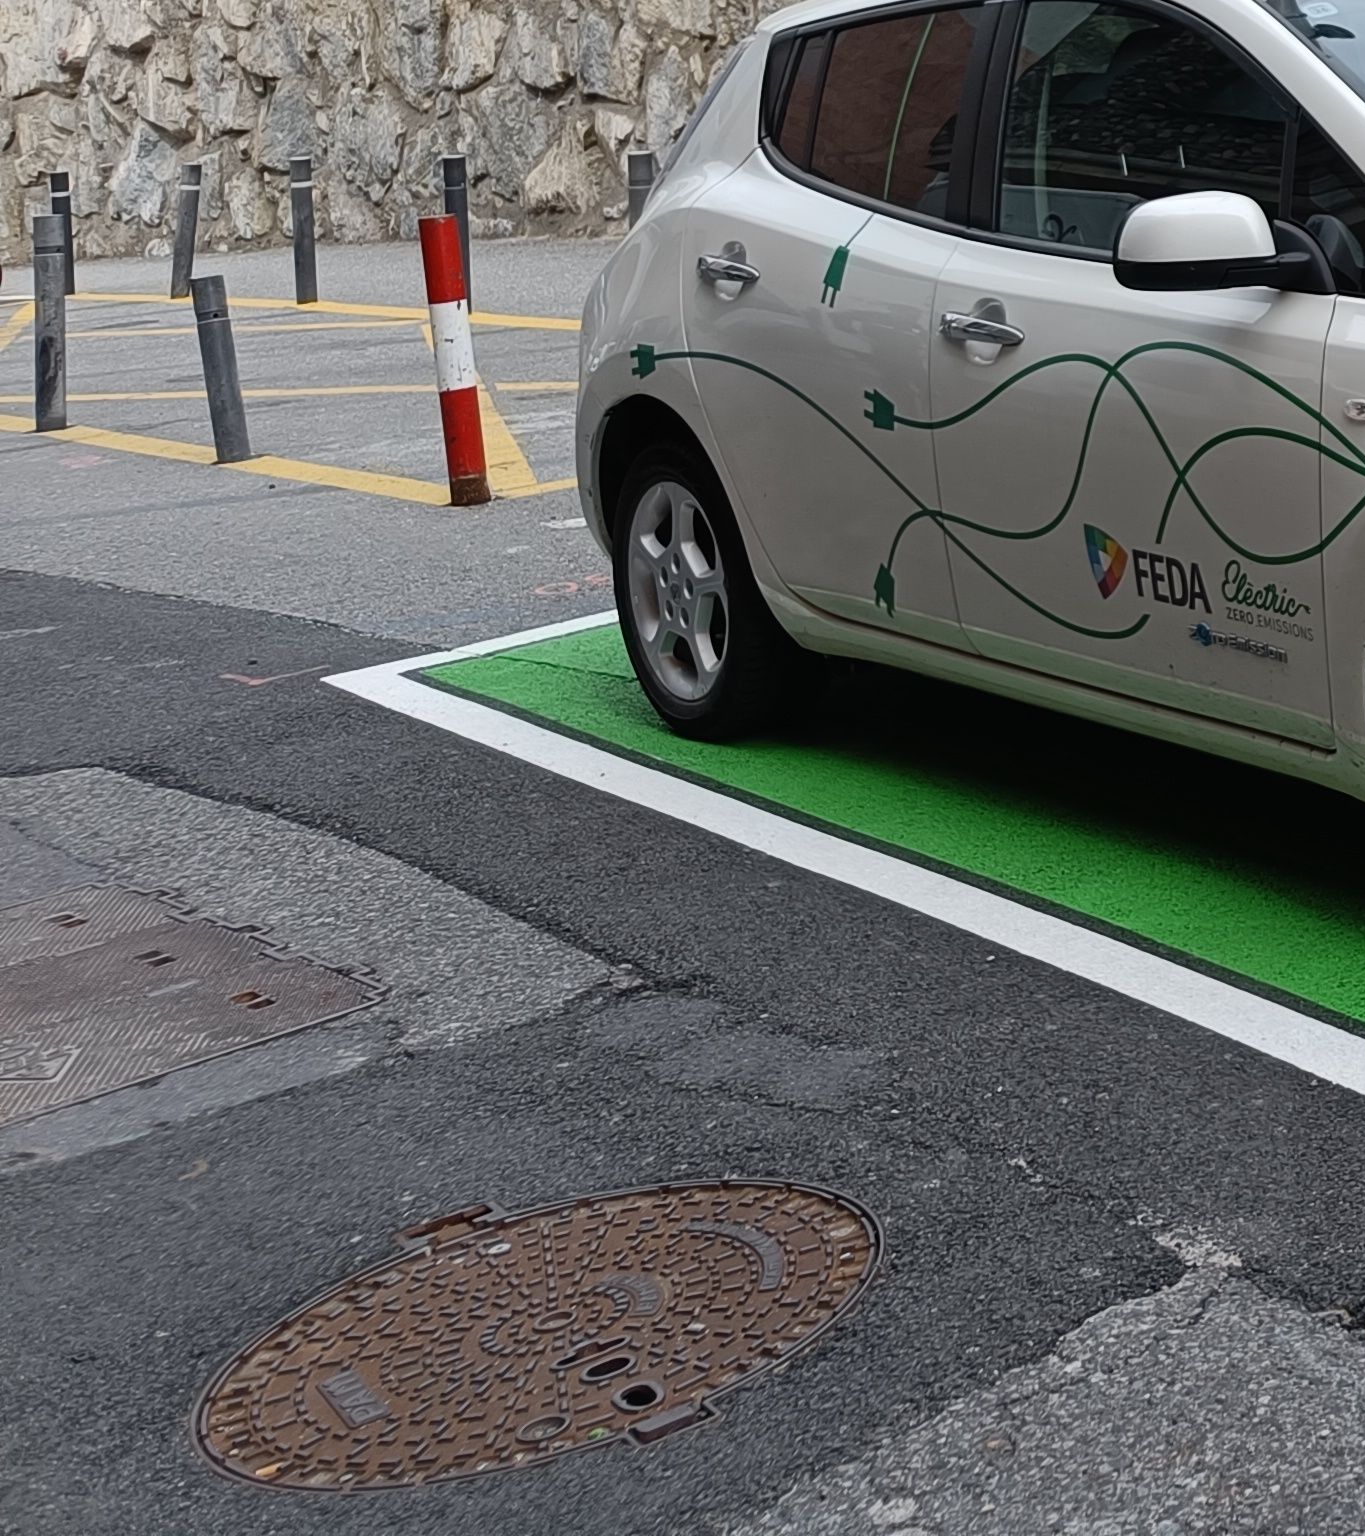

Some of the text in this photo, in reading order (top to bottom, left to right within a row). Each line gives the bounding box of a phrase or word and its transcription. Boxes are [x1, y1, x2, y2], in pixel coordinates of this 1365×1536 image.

[1132, 549, 1213, 614] FEDA
[1225, 606, 1315, 642] ZERO EMISSIONS
